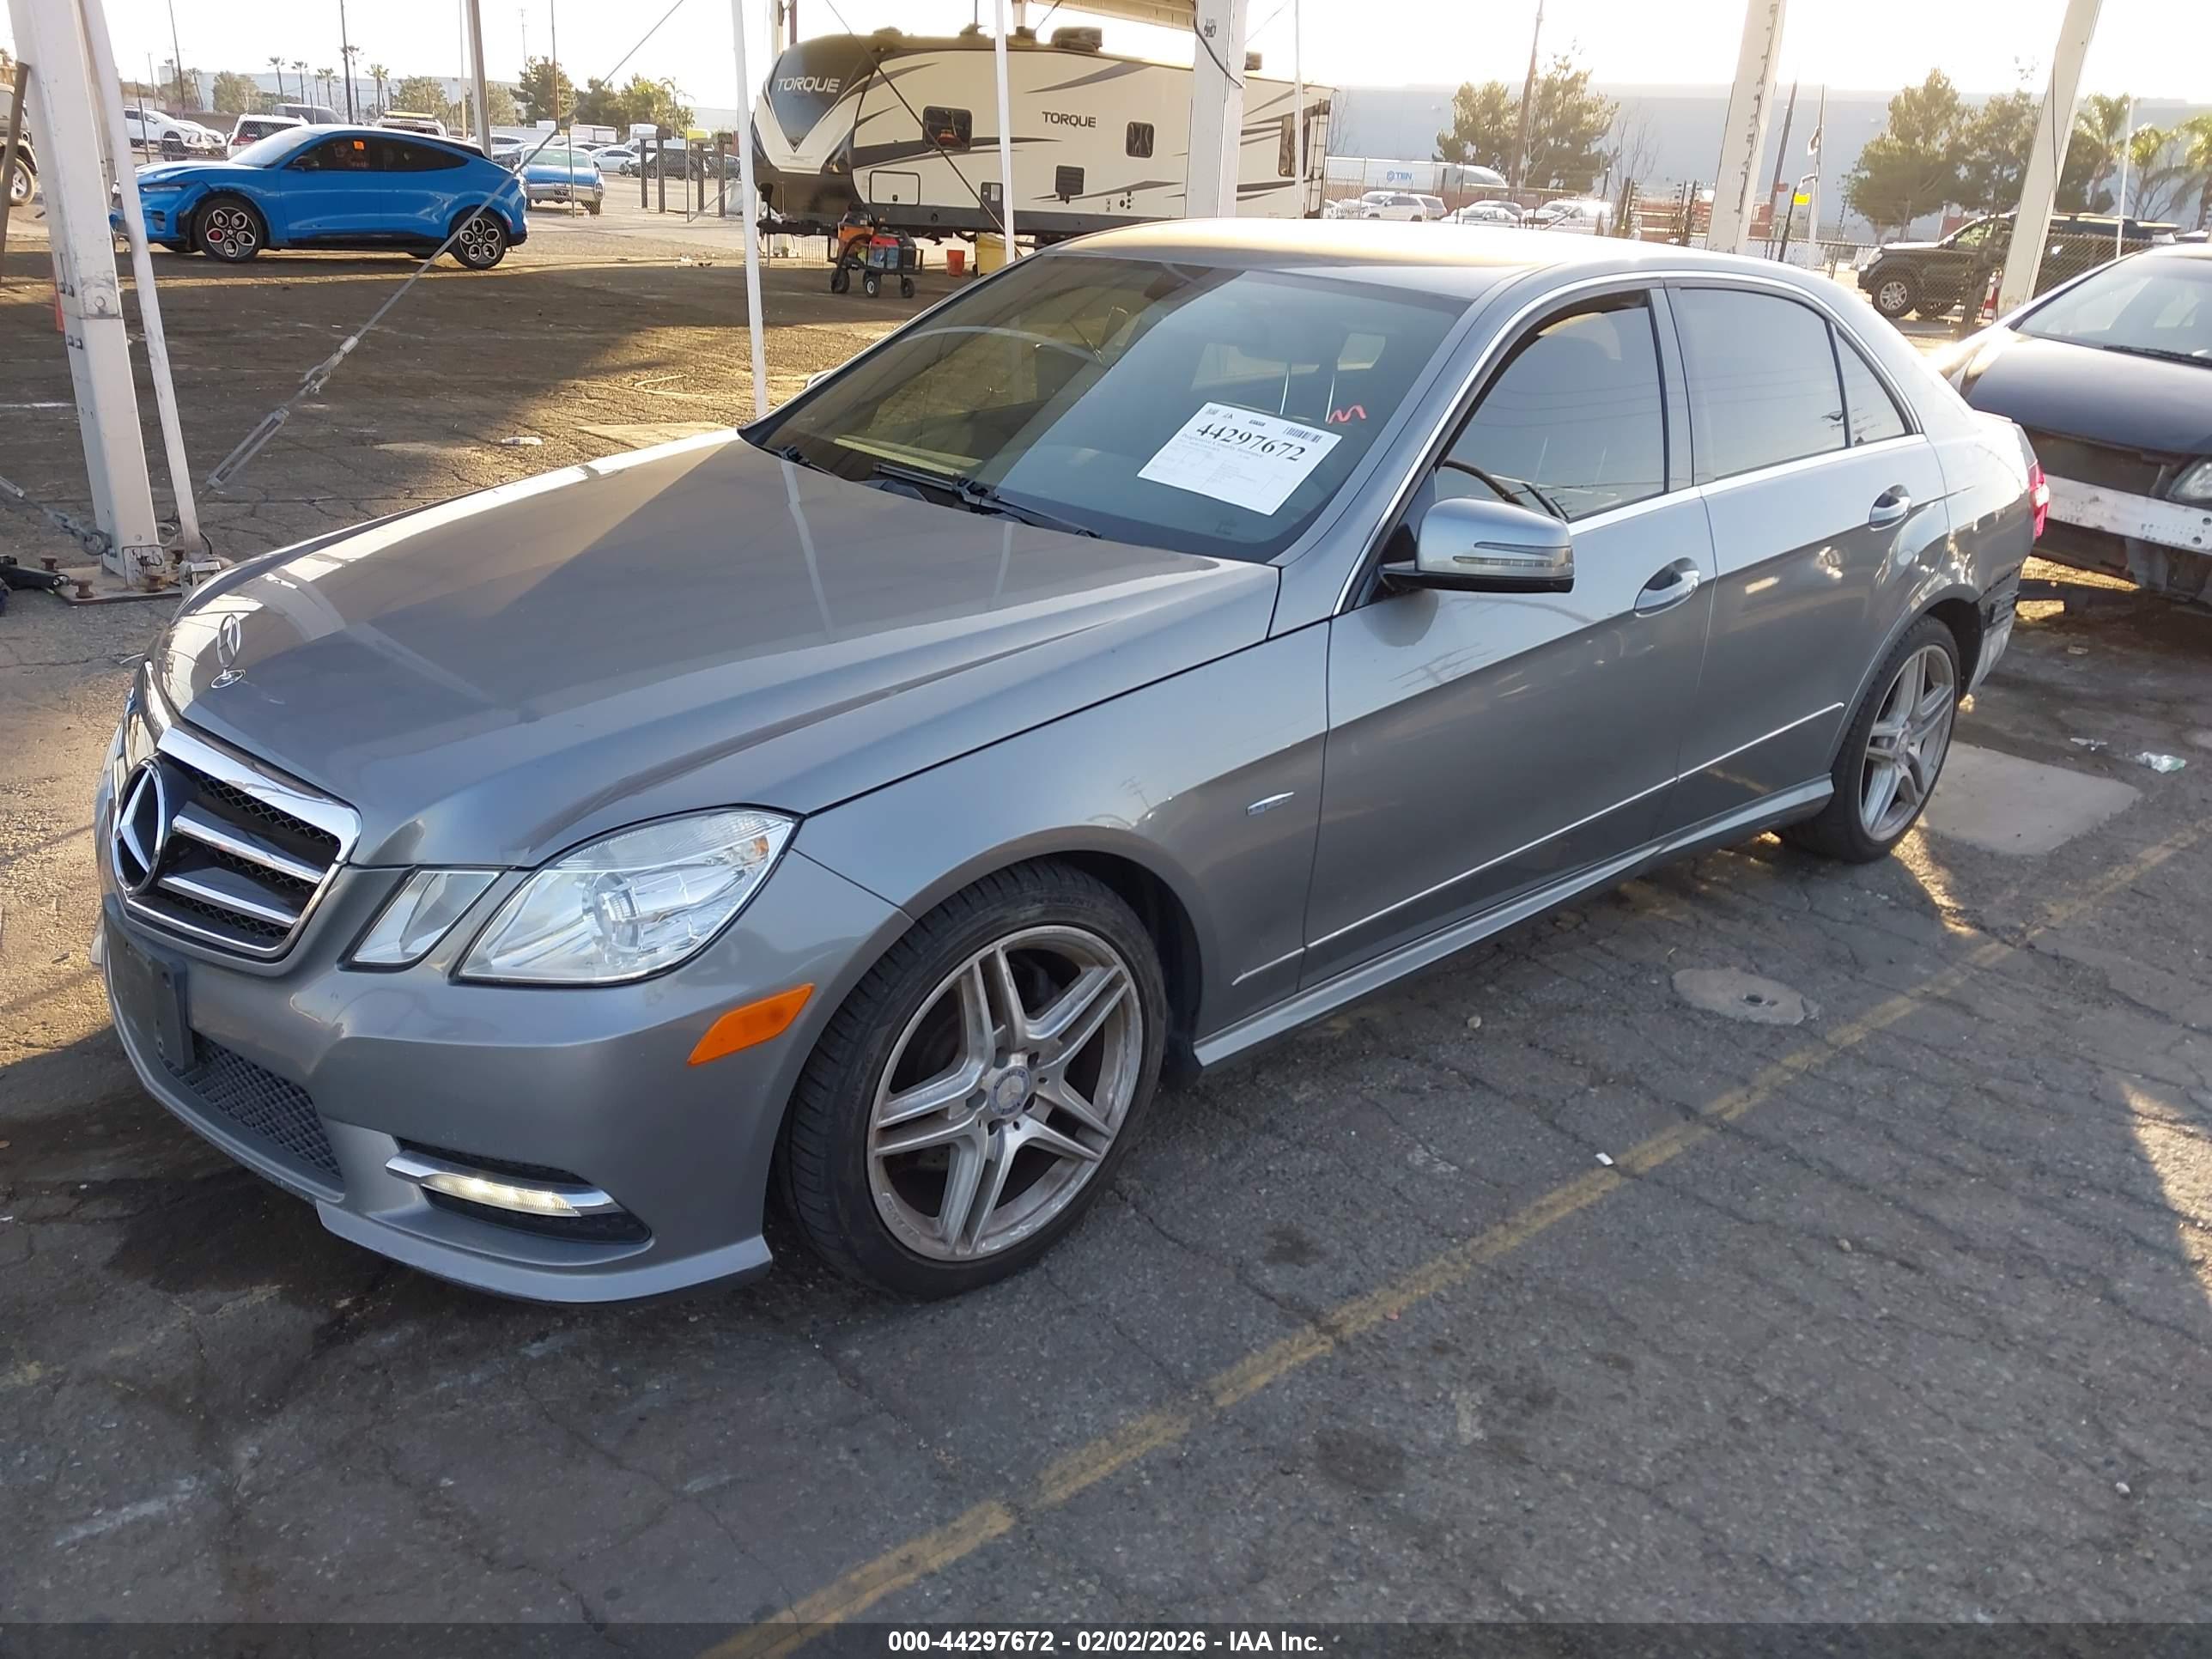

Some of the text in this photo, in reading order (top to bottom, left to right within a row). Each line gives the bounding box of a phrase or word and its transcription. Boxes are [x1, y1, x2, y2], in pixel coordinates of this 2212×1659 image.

[777, 76, 841, 93] TORQUE
[1042, 111, 1097, 128] TORQUE
[1196, 422, 1306, 462] 44297672
